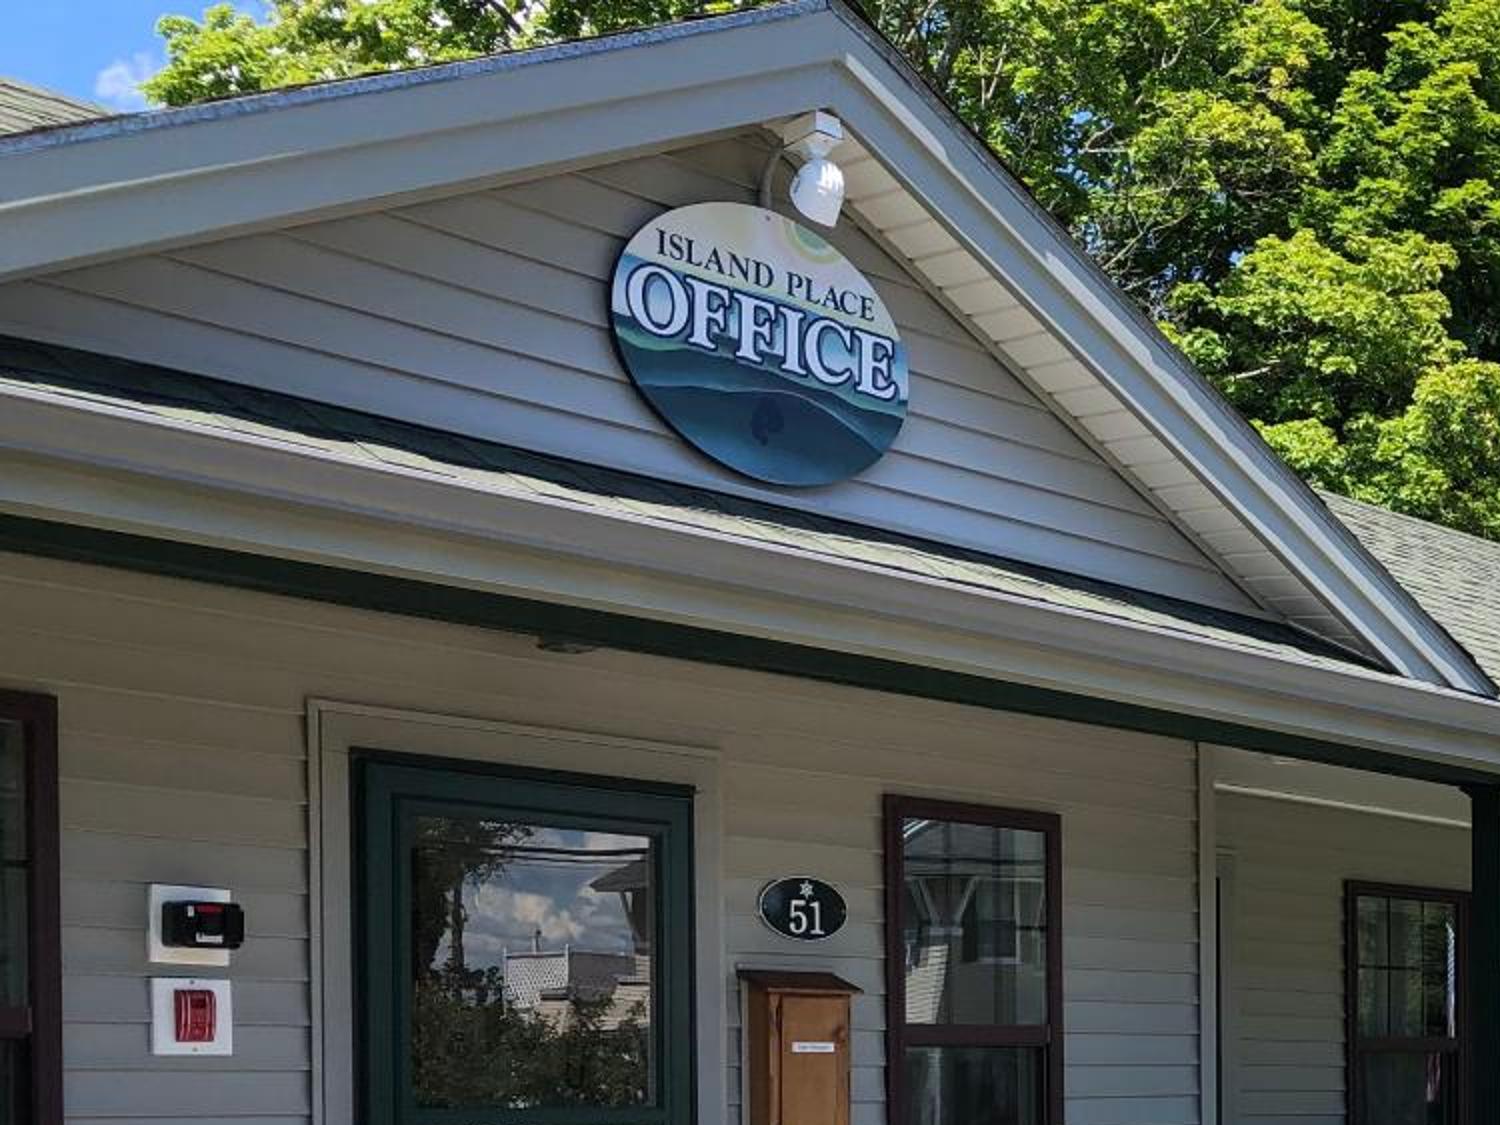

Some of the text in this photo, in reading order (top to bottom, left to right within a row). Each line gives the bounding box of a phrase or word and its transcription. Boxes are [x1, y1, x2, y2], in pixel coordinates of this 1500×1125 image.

[655, 227, 876, 321] ISLAND PLACE
[626, 262, 898, 401] OFFICE
[788, 899, 825, 936] 51
